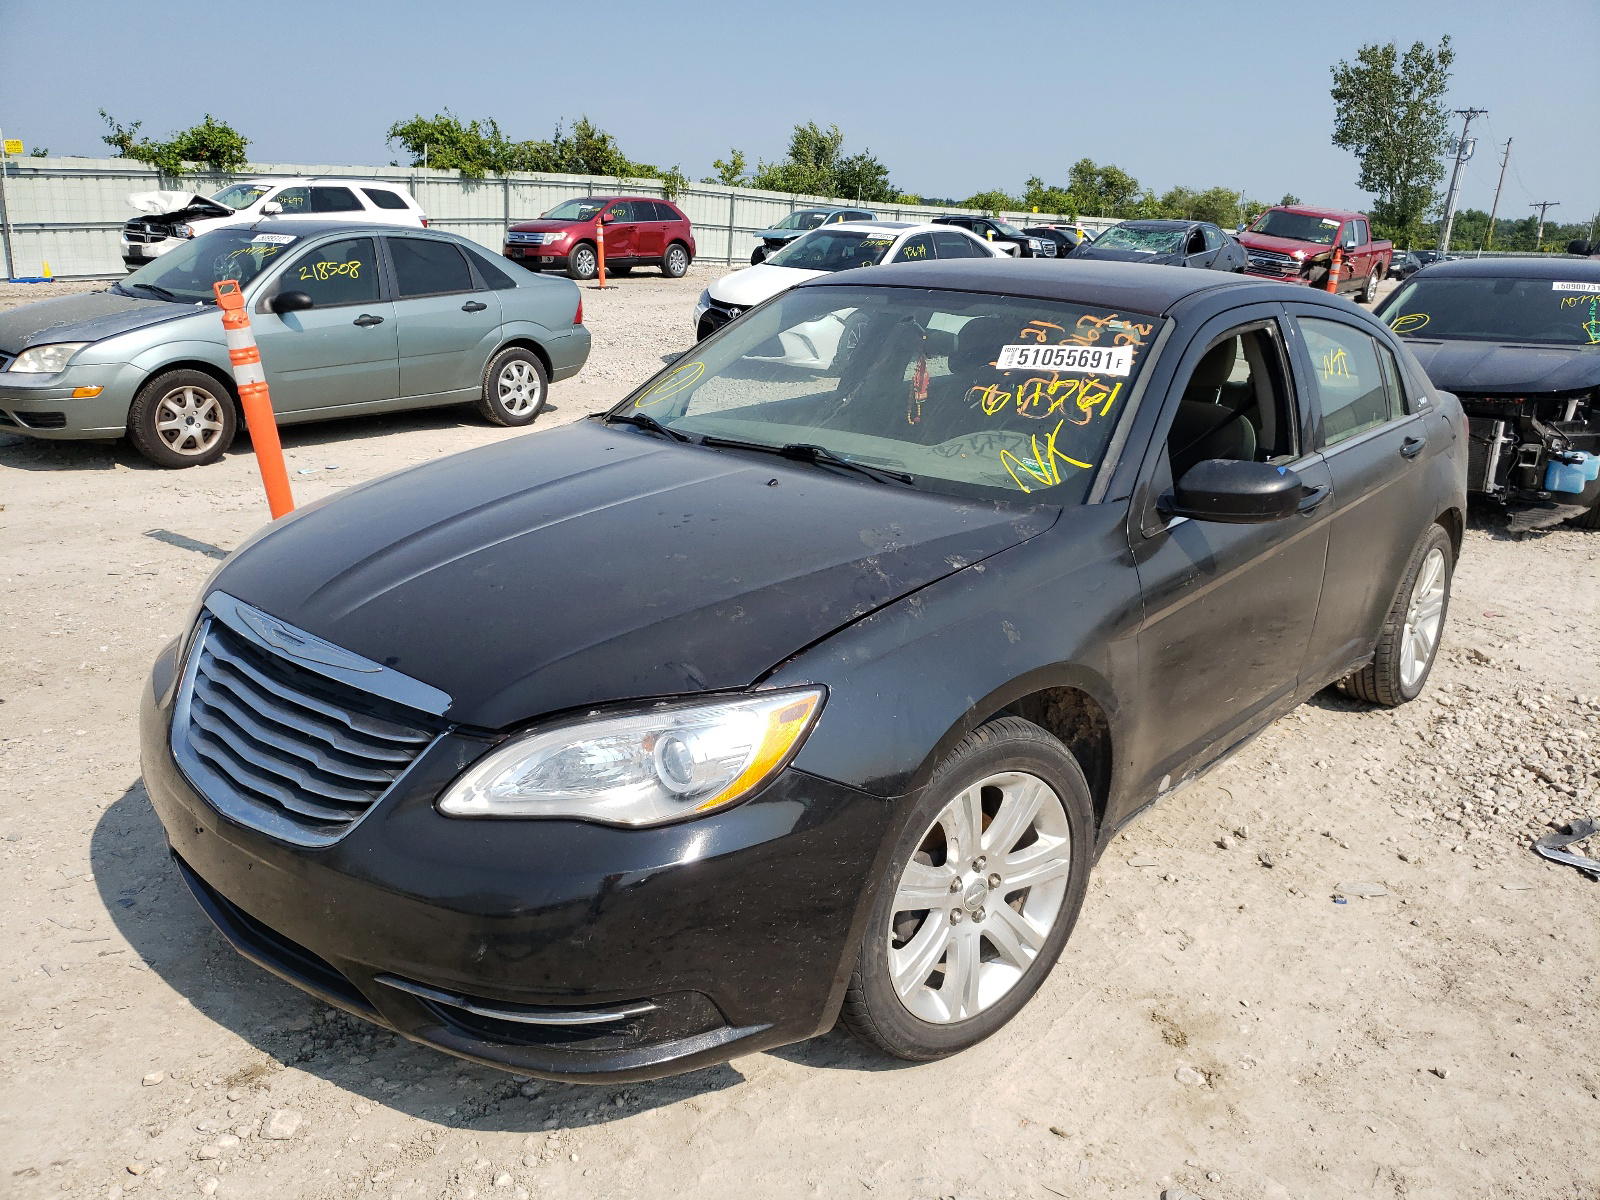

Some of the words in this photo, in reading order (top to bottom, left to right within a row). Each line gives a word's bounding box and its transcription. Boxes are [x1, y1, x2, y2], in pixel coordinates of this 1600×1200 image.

[299, 260, 362, 281] 218508
[1017, 348, 1113, 369] 51055691
[1116, 358, 1124, 368] F
[1000, 419, 1093, 494] NK
